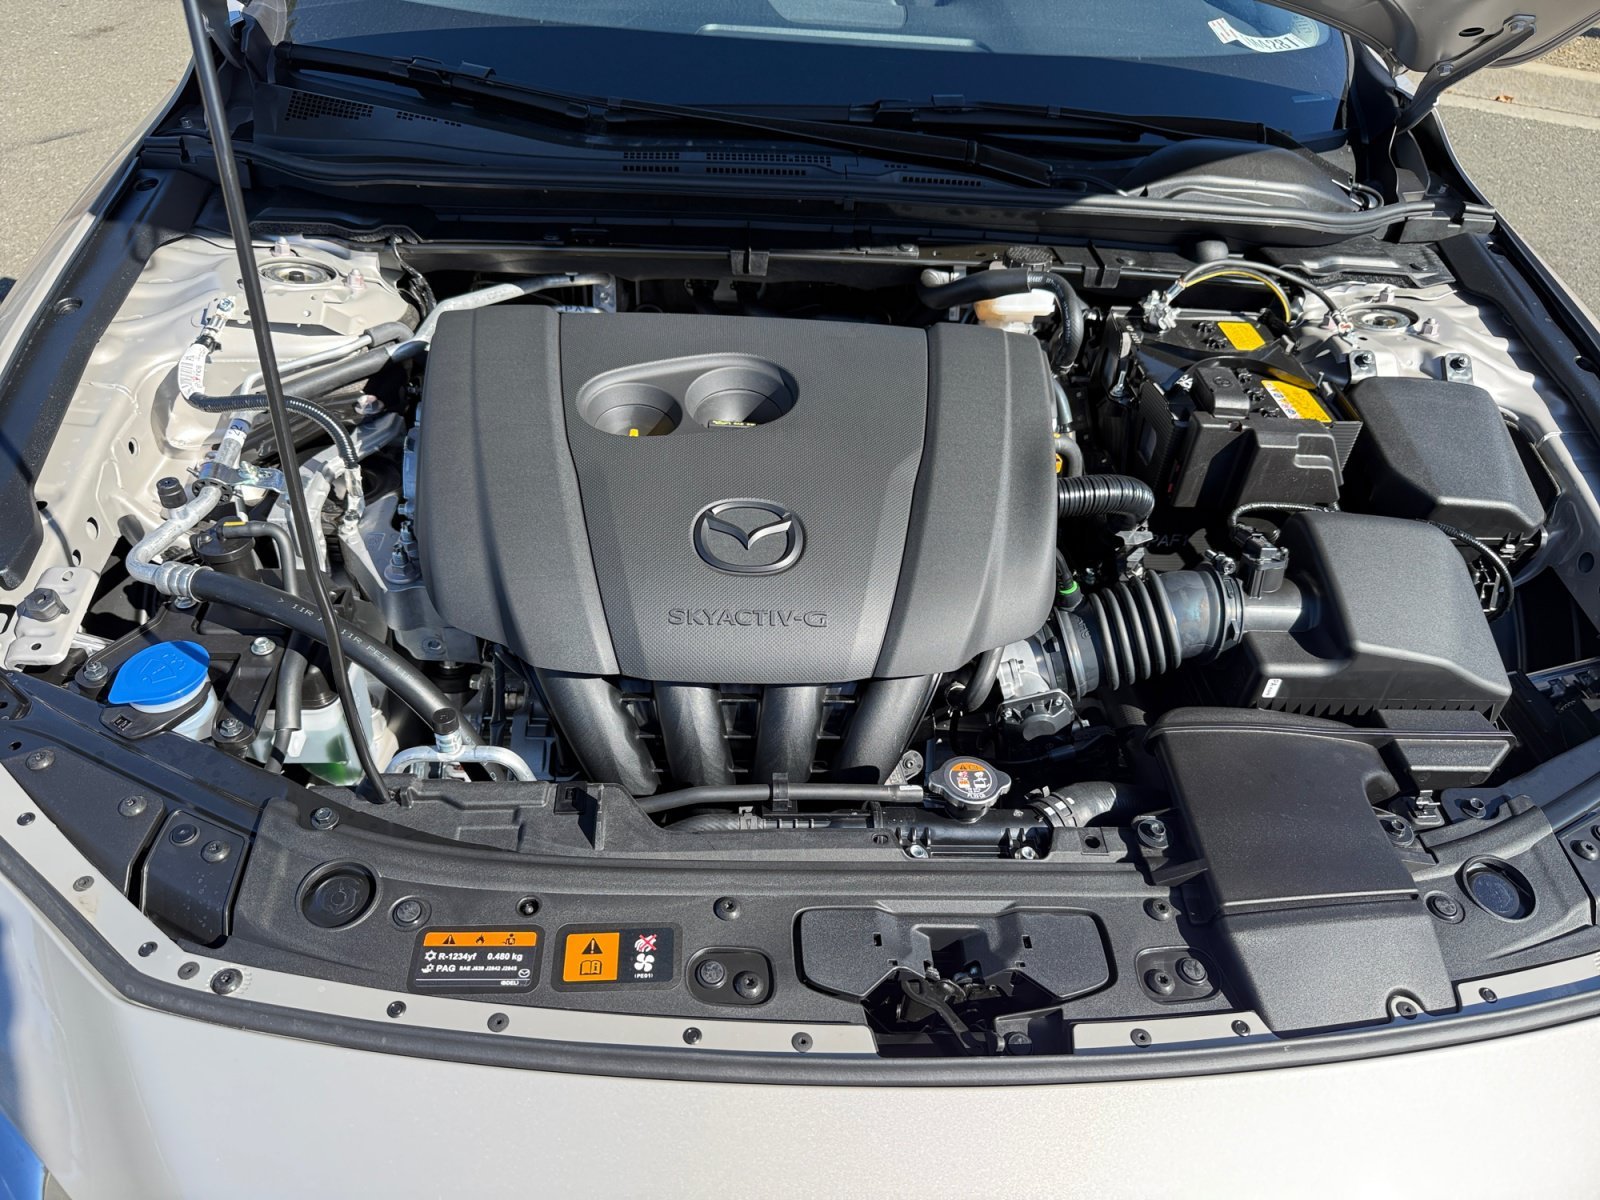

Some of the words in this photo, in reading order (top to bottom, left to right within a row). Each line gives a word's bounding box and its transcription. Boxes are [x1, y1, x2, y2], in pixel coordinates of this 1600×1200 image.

[667, 608, 828, 628] SKYACTIV-G
[365, 645, 391, 661] PET
[438, 952, 477, 962] R-1234yf
[487, 952, 511, 960] 0.480
[511, 952, 523, 962] kg
[435, 964, 456, 972] PAG
